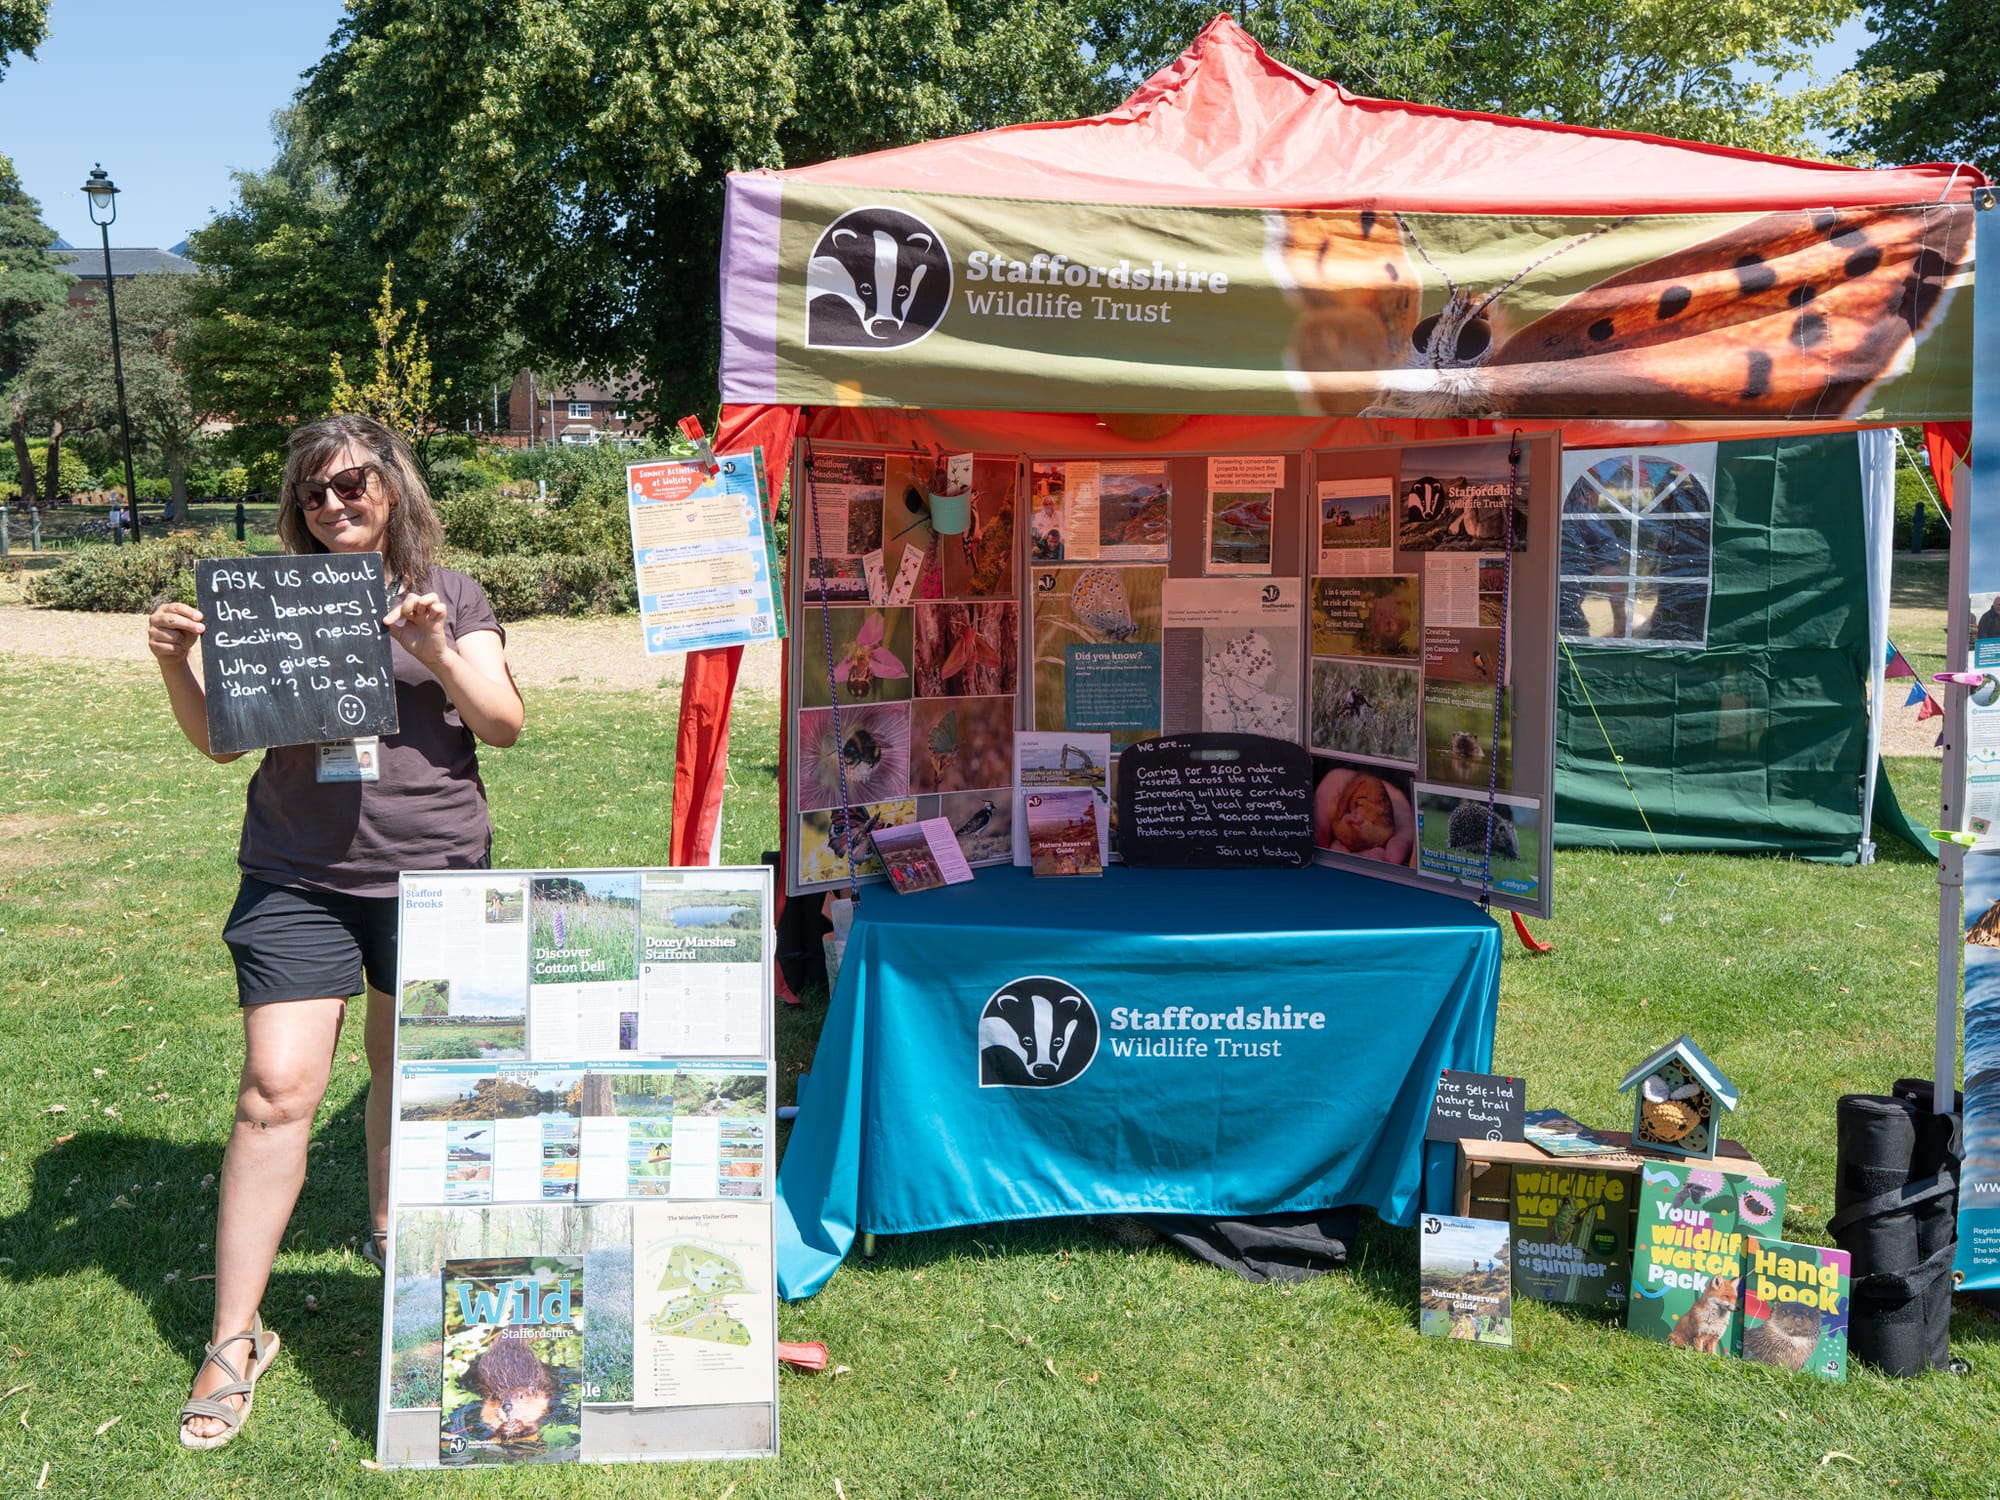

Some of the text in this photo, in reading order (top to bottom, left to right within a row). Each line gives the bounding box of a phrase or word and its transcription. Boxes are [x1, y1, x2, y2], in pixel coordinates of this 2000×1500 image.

[966, 251, 1229, 294] Staffordshire
[965, 289, 1172, 323] Wildlife Trust
[1448, 484, 1523, 498] Staffordshie
[1483, 498, 1508, 508] Trust
[312, 560, 377, 584] about
[216, 600, 258, 621] the
[216, 620, 382, 649] Exciting news!
[1075, 651, 1143, 662] Did you know?
[219, 654, 364, 676] Who gives a
[311, 676, 347, 691] We
[1137, 743, 1154, 753] We
[1137, 765, 1179, 780] Caring
[1184, 767, 1202, 777] for
[1247, 763, 1286, 775] nature
[1139, 774, 1273, 787] reserves across the UK
[1135, 787, 1306, 803] Increasing wildlife corridors
[1134, 798, 1286, 816] Supported by local groups,
[1136, 813, 1185, 825] volunteers
[1190, 813, 1213, 822] and
[1265, 812, 1310, 822] members
[1137, 826, 1314, 839] Protecting areas from development
[1215, 845, 1302, 864] Join us today
[405, 889, 443, 898] Stafford
[406, 899, 444, 909] Brooks
[644, 936, 737, 949] Doxey Marshes
[536, 947, 592, 960] Discover
[644, 949, 697, 961] Stafford
[536, 960, 606, 975] Cotton Dell
[1110, 1004, 1326, 1031] Staffordshire
[1110, 1037, 1282, 1058] Wildlife Trust
[1437, 1077, 1461, 1092] Free
[1436, 1094, 1509, 1112] nature trail
[1436, 1105, 1502, 1128] here today
[1516, 1171, 1625, 1202] Wildlife
[1655, 1200, 1710, 1226] Your
[1517, 1238, 1584, 1260] Sounds
[1518, 1257, 1530, 1268] of
[1754, 1250, 1839, 1289] Hand
[454, 1279, 574, 1326] Wild
[1431, 1289, 1500, 1304] Nature Reserves
[1756, 1275, 1841, 1316] book
[1452, 1300, 1478, 1311] Guide
[502, 1327, 574, 1340] Staffordshire
